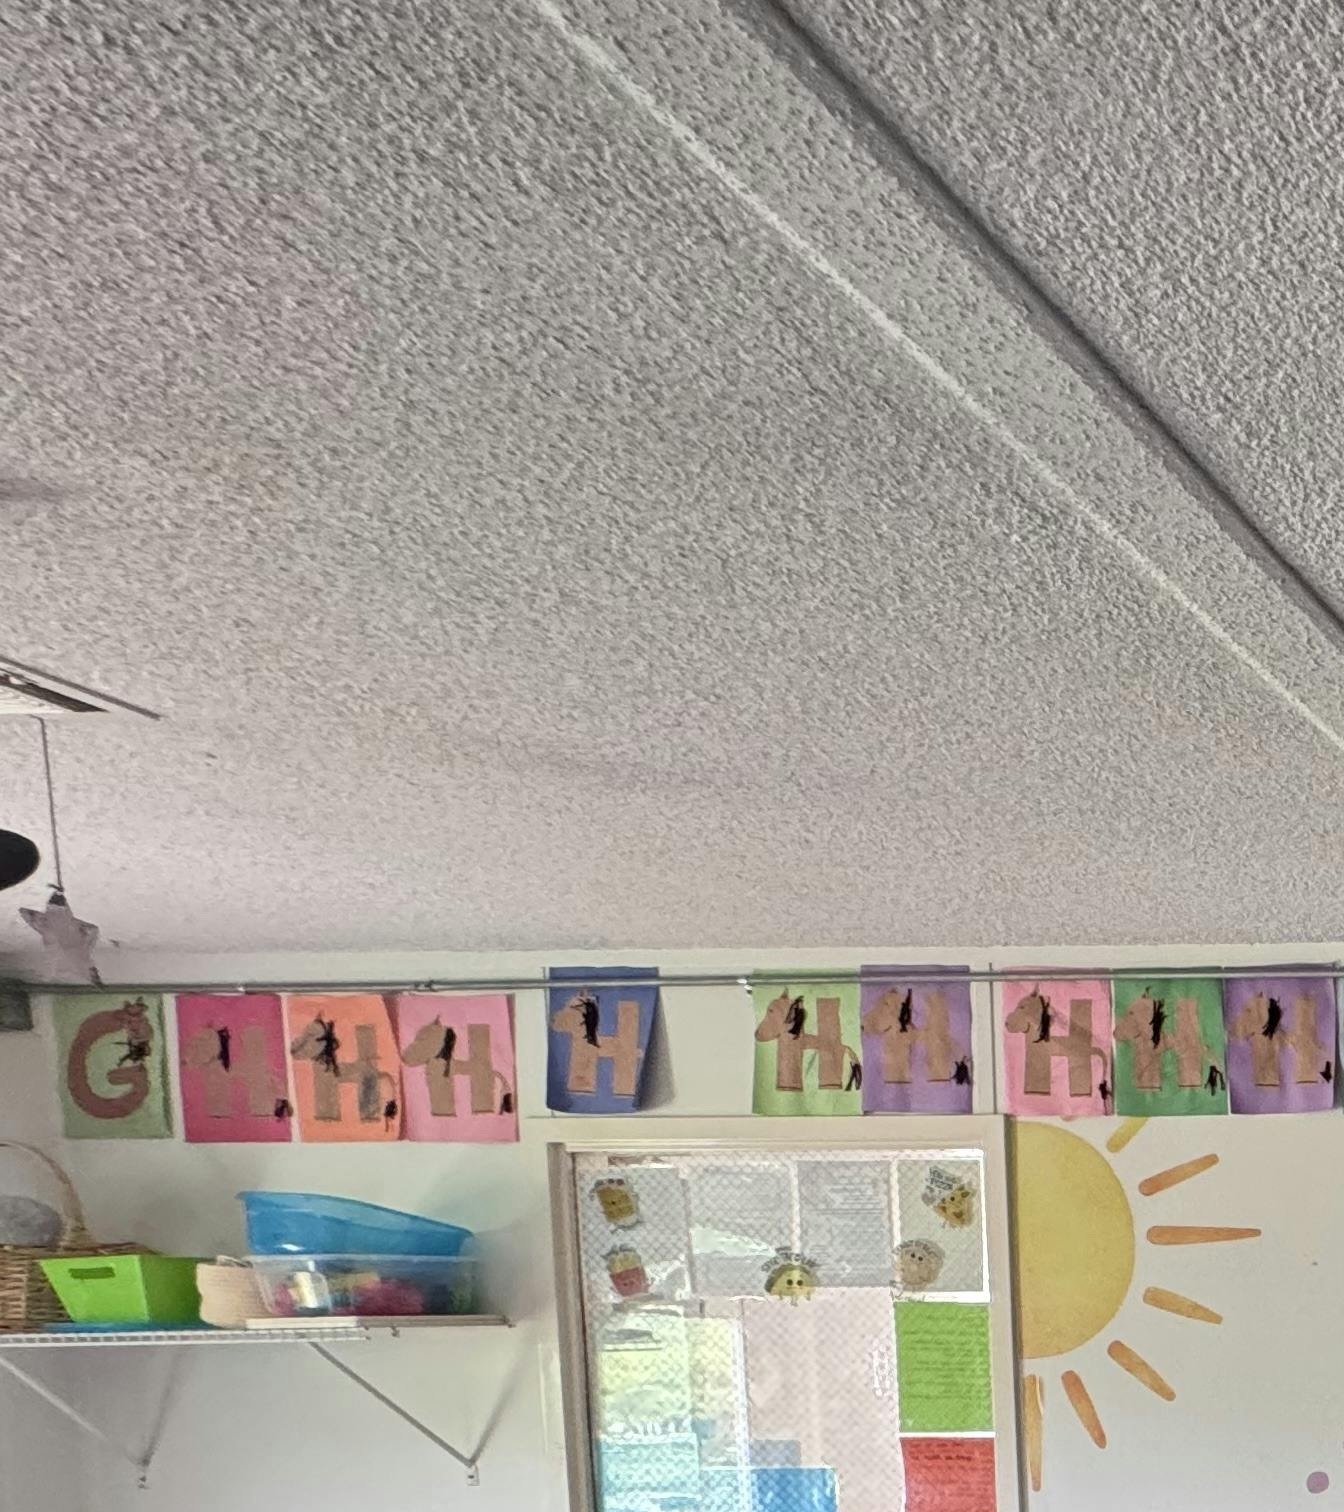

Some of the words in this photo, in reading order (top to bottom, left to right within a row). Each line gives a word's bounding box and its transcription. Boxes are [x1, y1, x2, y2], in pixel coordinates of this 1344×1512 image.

[67, 1000, 152, 1119] G
[292, 1018, 384, 1121] H
[401, 1022, 496, 1116] H
[551, 995, 640, 1096] H
[755, 996, 845, 1090] H
[862, 990, 954, 1084] H
[1005, 994, 1094, 1096] H
[1113, 994, 1203, 1089] H
[1233, 996, 1322, 1086] H
